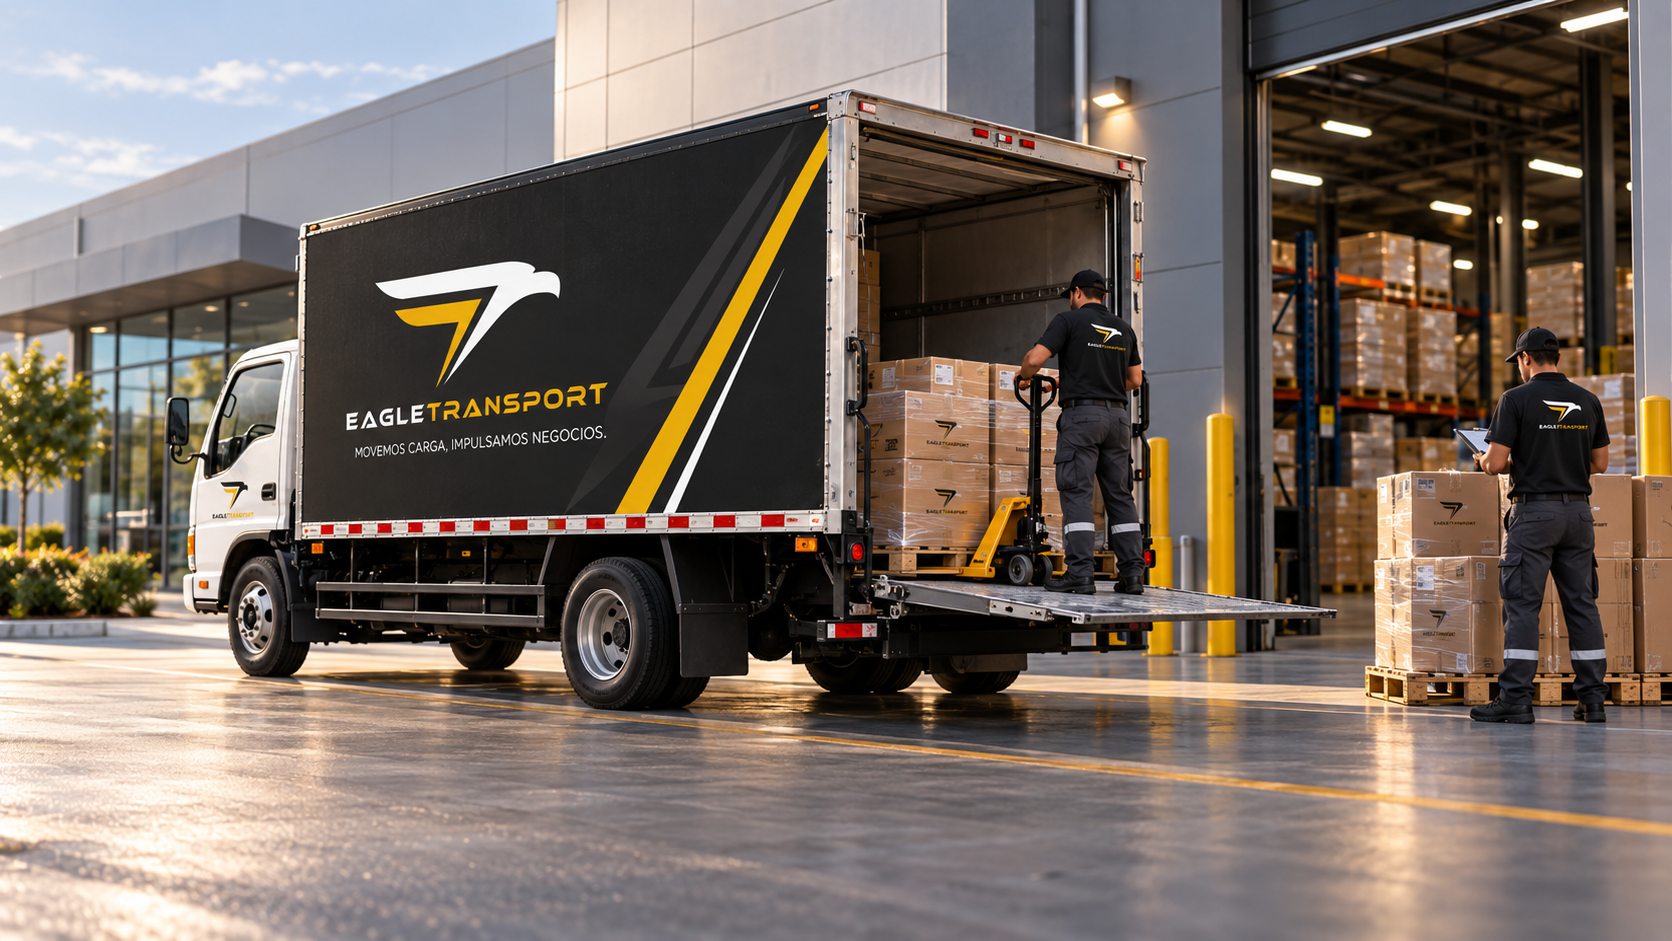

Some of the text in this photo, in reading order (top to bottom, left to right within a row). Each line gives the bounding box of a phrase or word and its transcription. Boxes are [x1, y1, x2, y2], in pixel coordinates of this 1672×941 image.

[346, 382, 608, 431] EAGLETRANSPORT
[354, 425, 607, 459] MOVEMOS CARGA, IMPULSAMOS NEGOCIOS.
